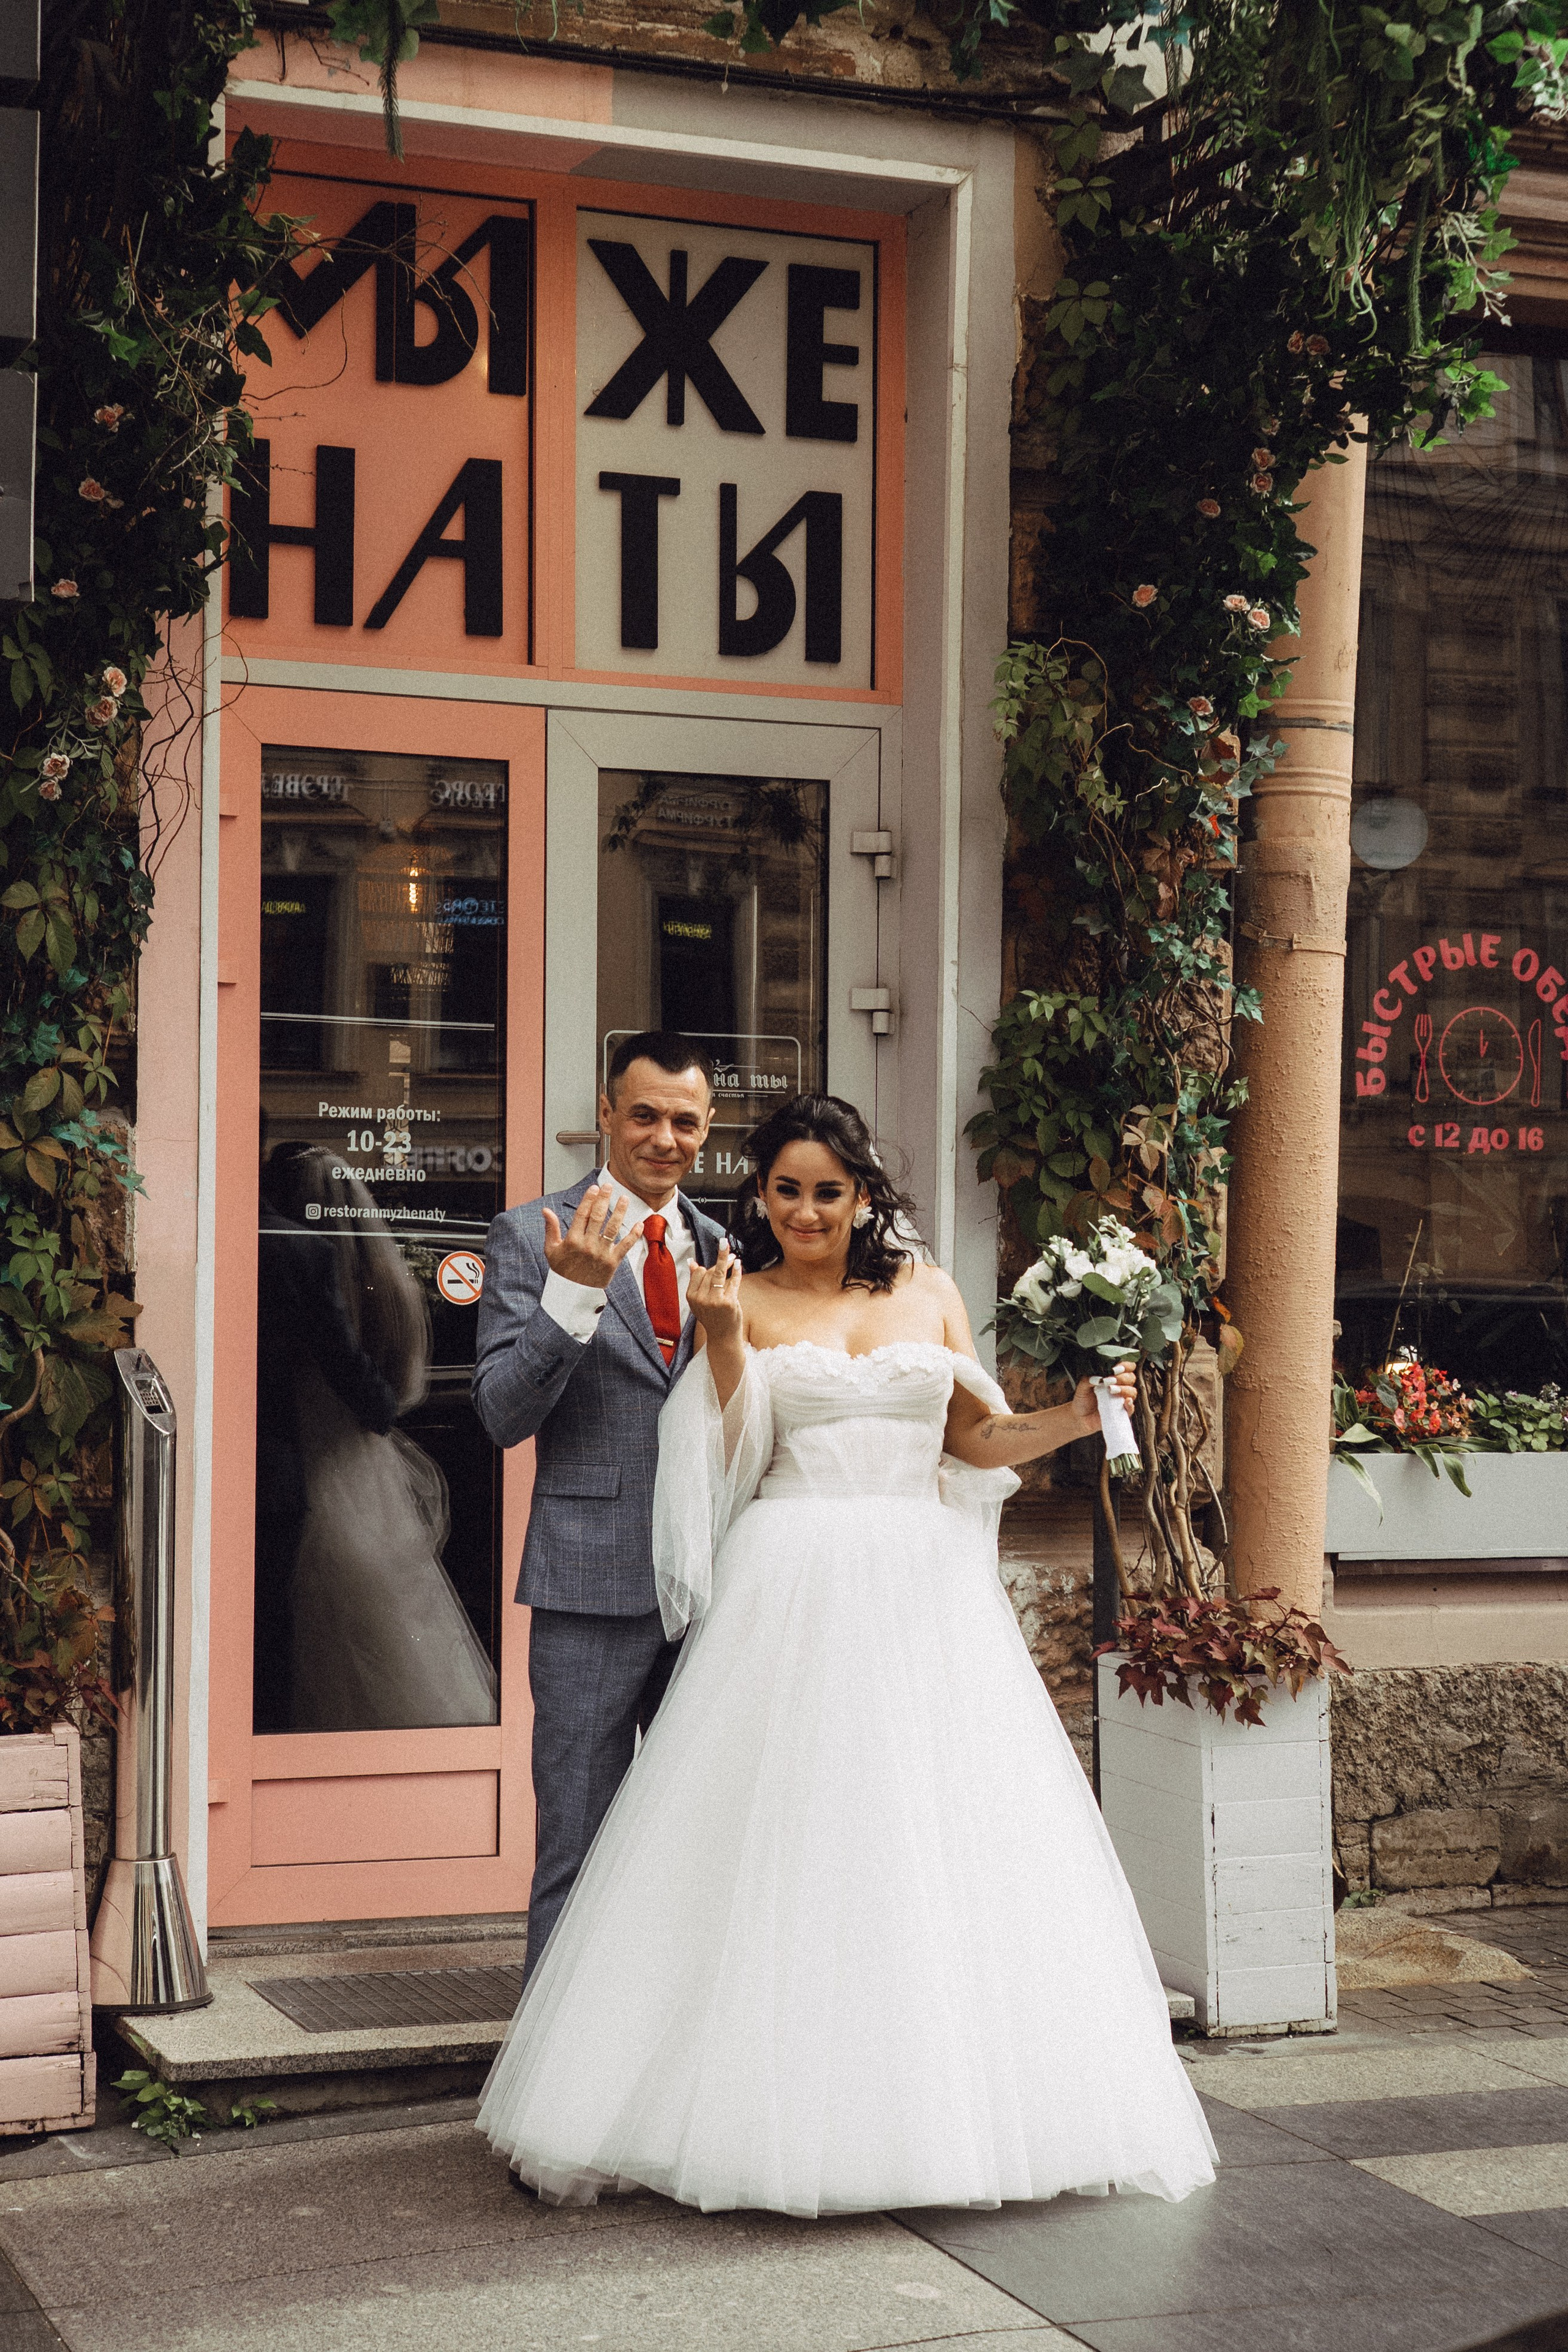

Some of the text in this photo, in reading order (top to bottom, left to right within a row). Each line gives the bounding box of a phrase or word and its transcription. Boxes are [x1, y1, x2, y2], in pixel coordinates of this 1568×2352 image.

[583, 239, 860, 442] ЖЕ
[229, 437, 842, 663] НА ТЫ
[1355, 933, 1501, 1096] БЫСТРЫЕ
[318, 1101, 440, 1123] Режим работы:
[347, 1129, 412, 1154] 10-23
[1434, 1122, 1460, 1148] 12
[1518, 1127, 1544, 1152] 16
[331, 1166, 426, 1182] ежедневно
[688, 1152, 748, 1174] Е НА
[323, 1204, 446, 1223] restoranmyzhenaty
